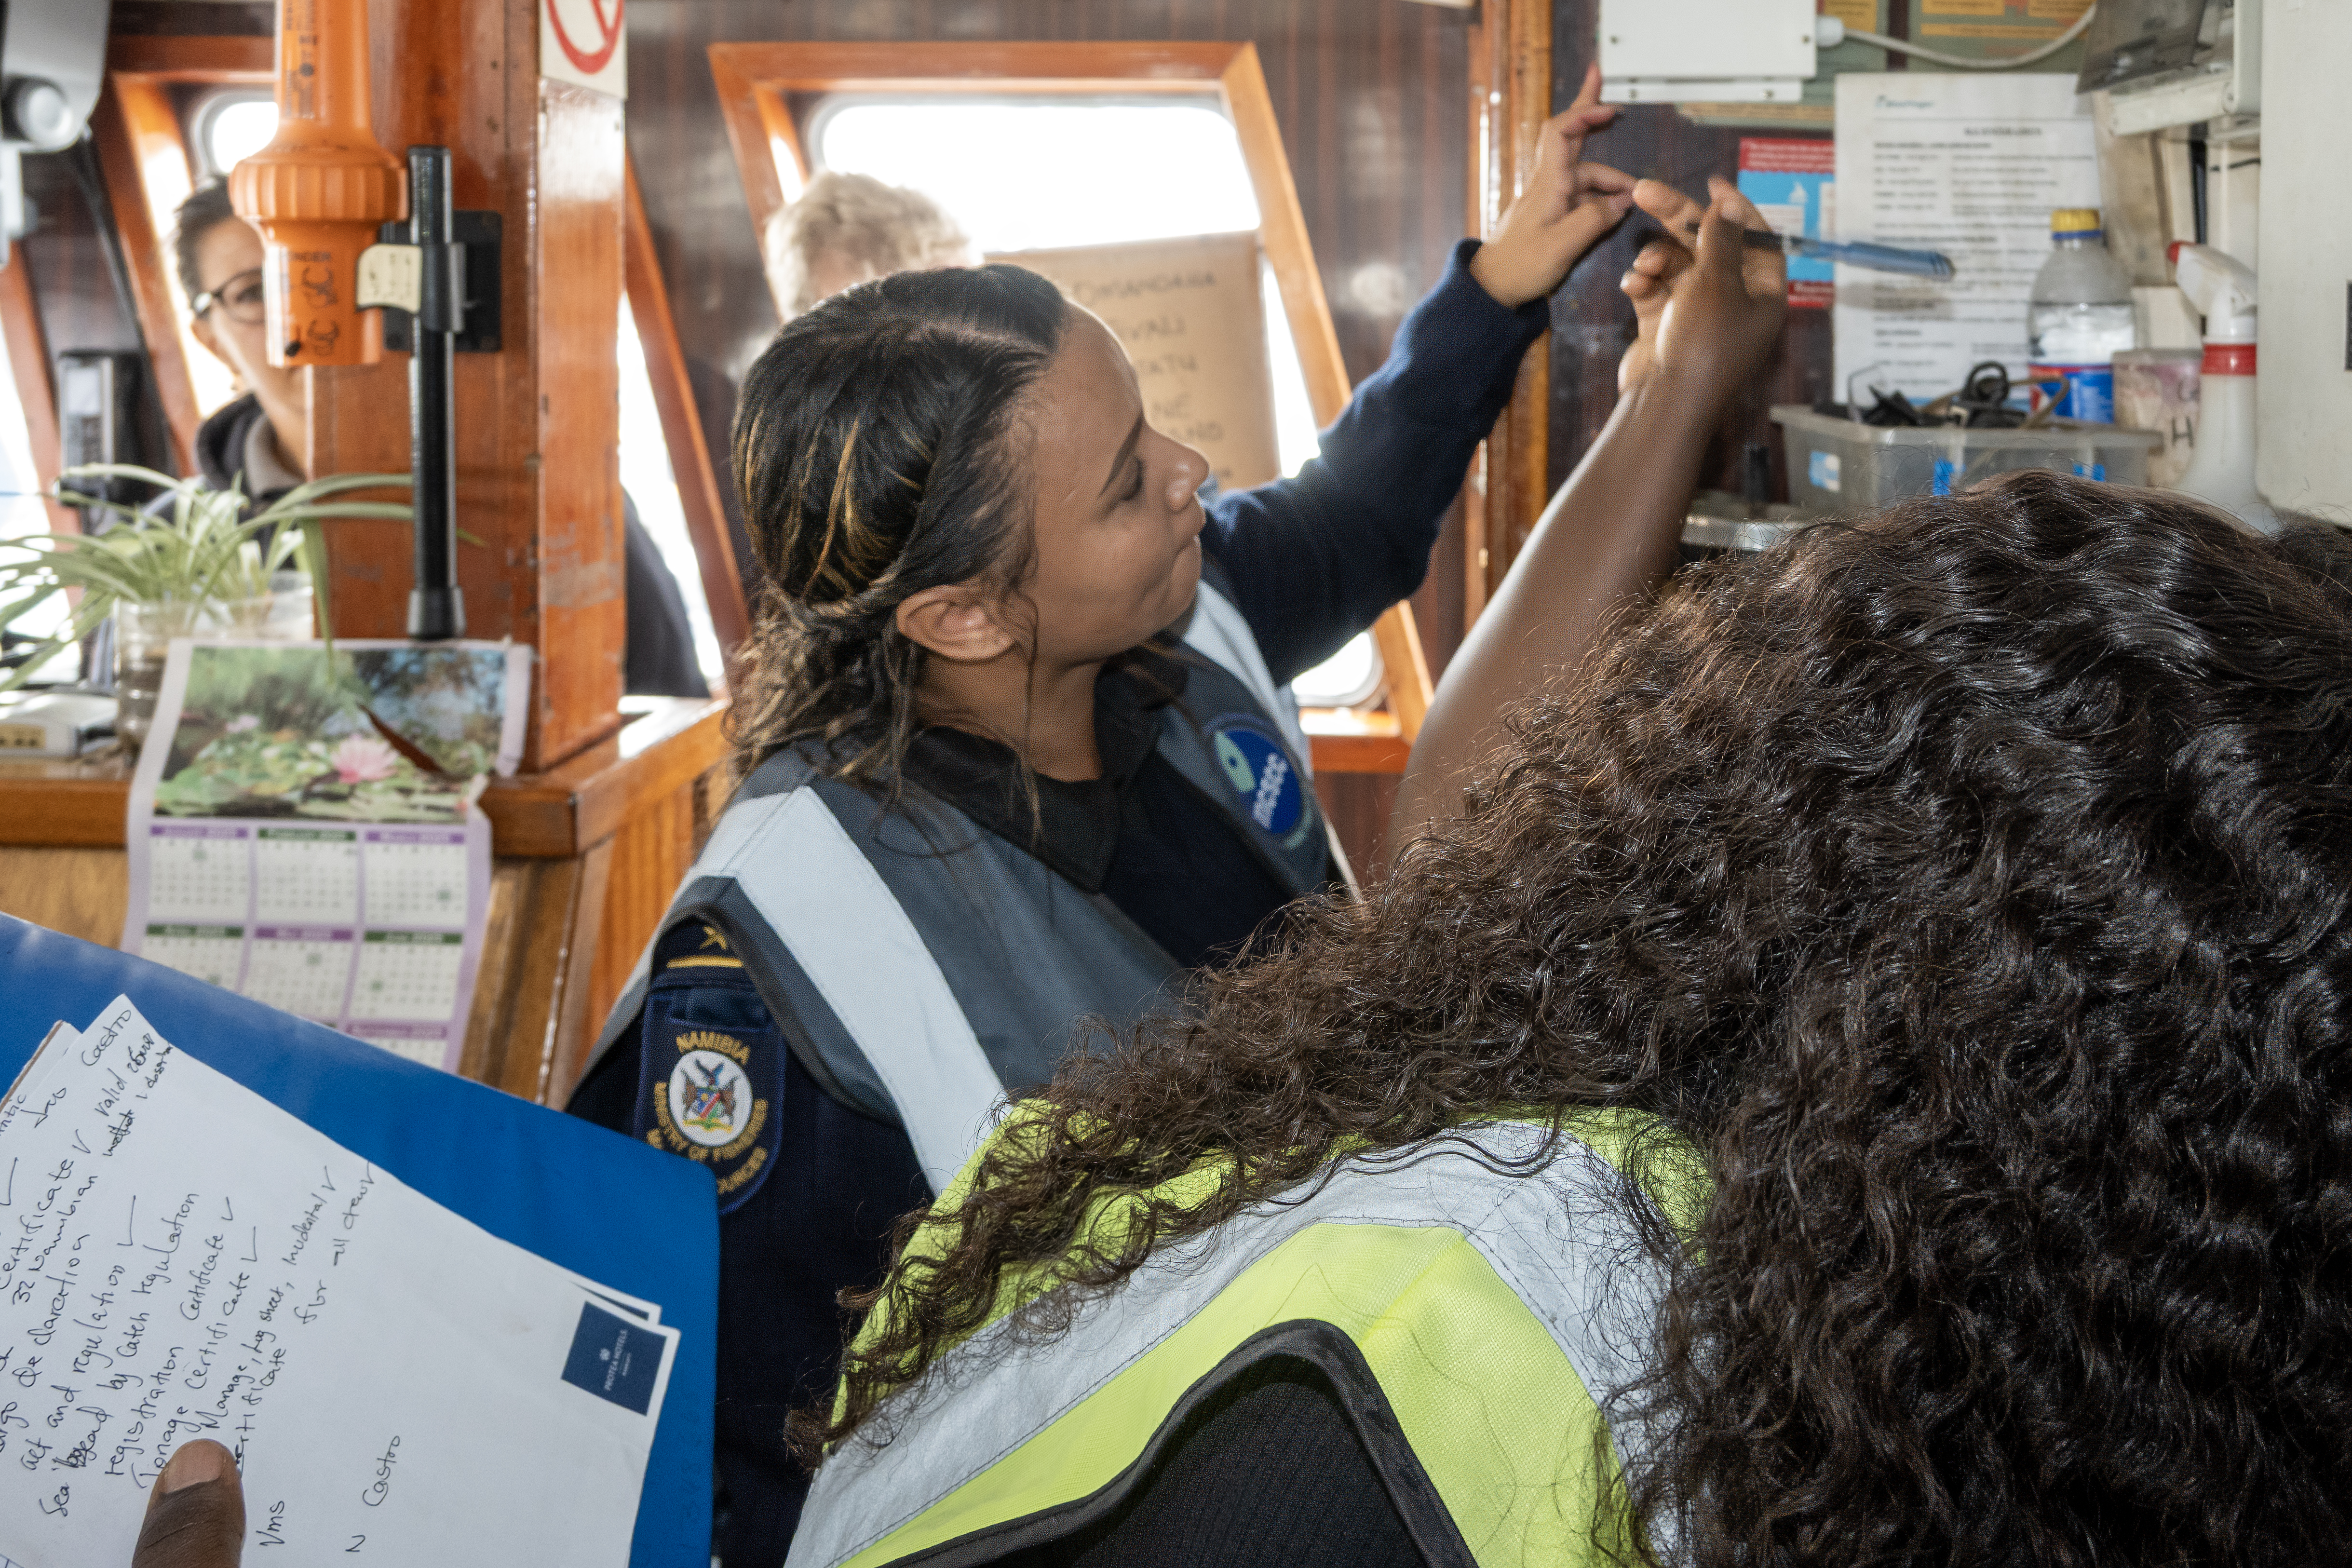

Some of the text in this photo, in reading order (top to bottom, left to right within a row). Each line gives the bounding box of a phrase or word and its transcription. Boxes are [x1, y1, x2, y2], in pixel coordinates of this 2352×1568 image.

[81, 1010, 131, 1067] Castro
[676, 1031, 750, 1065] NAMIBIA
[604, 1361, 618, 1391] PROTEA
[614, 1330, 627, 1359] HOTELS
[47, 1385, 81, 1428] and
[105, 1347, 184, 1475] registration
[234, 1348, 286, 1465] ertificate
[362, 1435, 400, 1507] Castro
